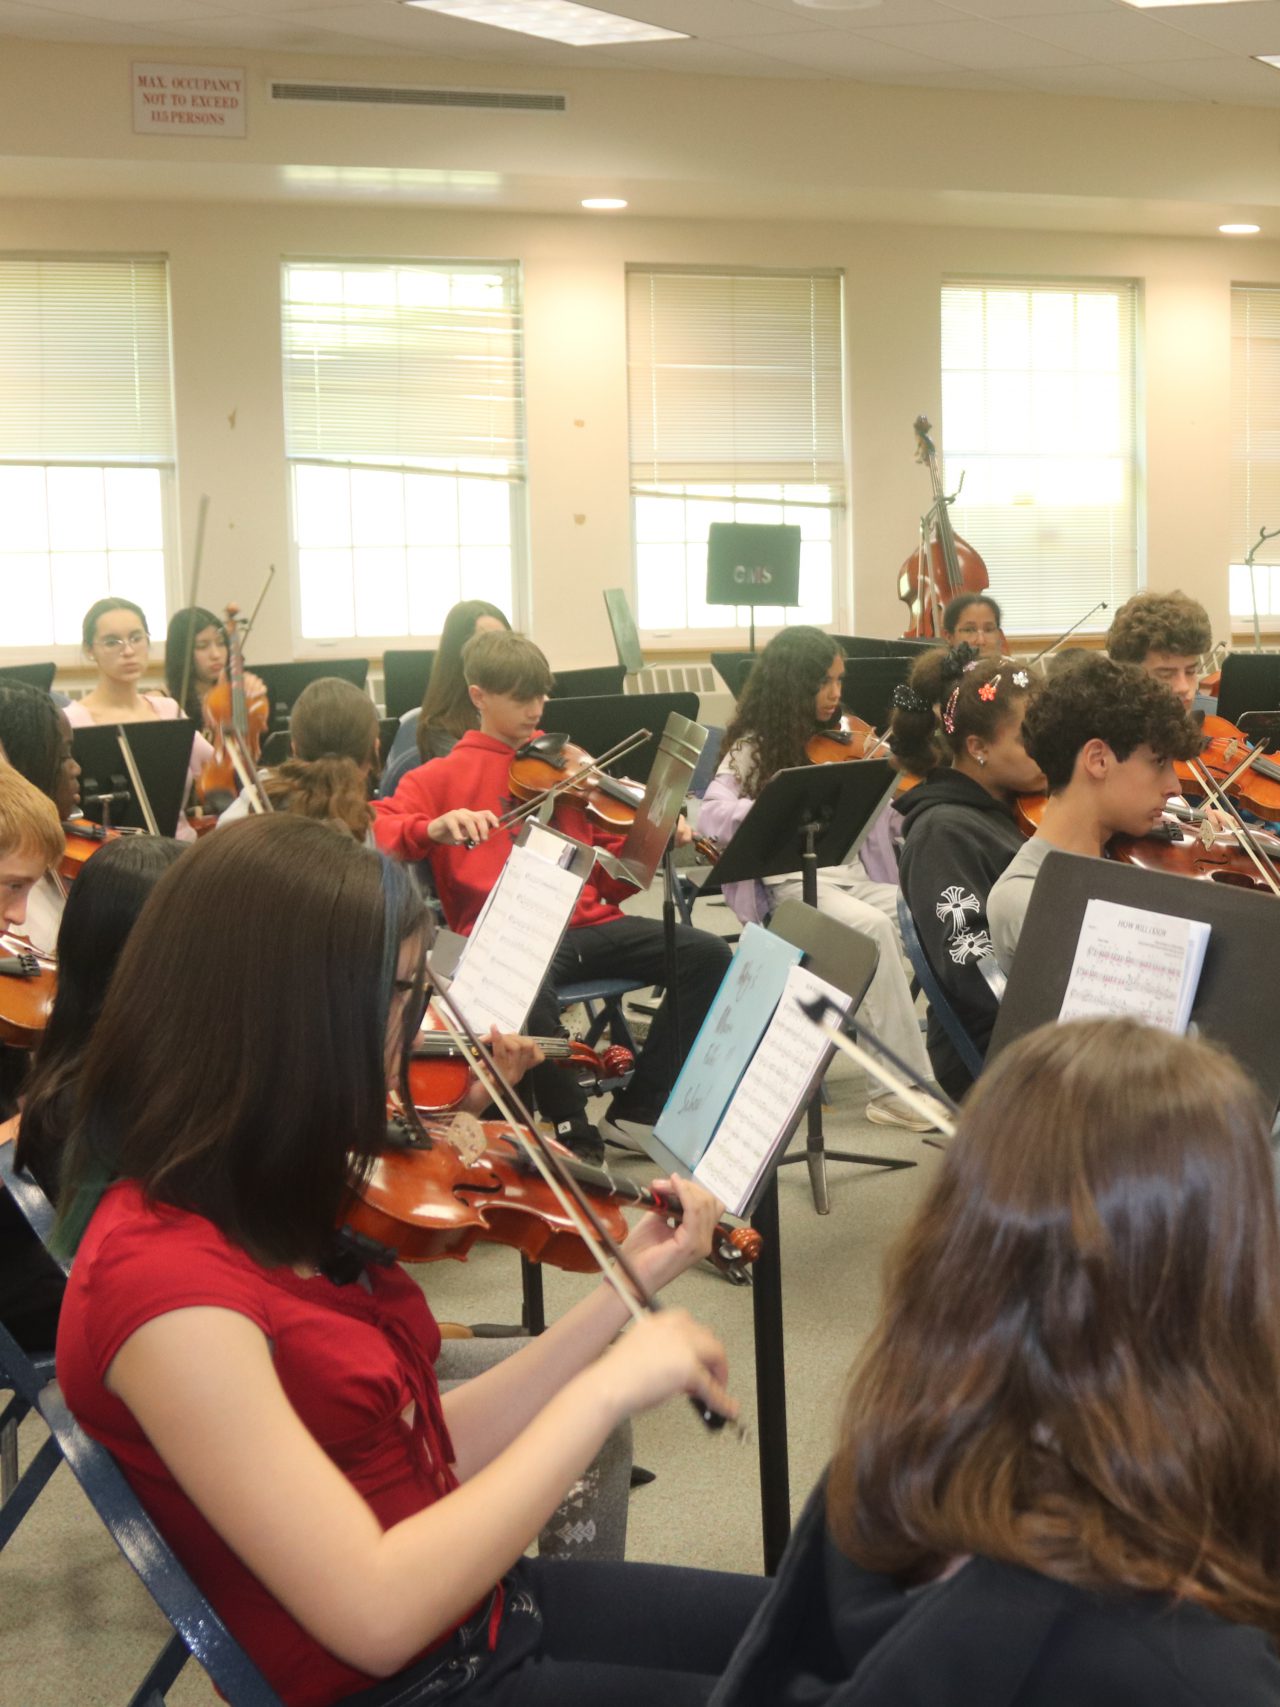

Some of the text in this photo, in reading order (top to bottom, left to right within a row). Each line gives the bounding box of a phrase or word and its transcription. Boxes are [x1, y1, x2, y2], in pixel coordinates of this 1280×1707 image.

[138, 75, 241, 92] MAX. OCCUPANCY
[143, 92, 239, 109] NOT TO EXCEED
[171, 111, 225, 125] PERSONS
[1117, 919, 1134, 929] HOW
